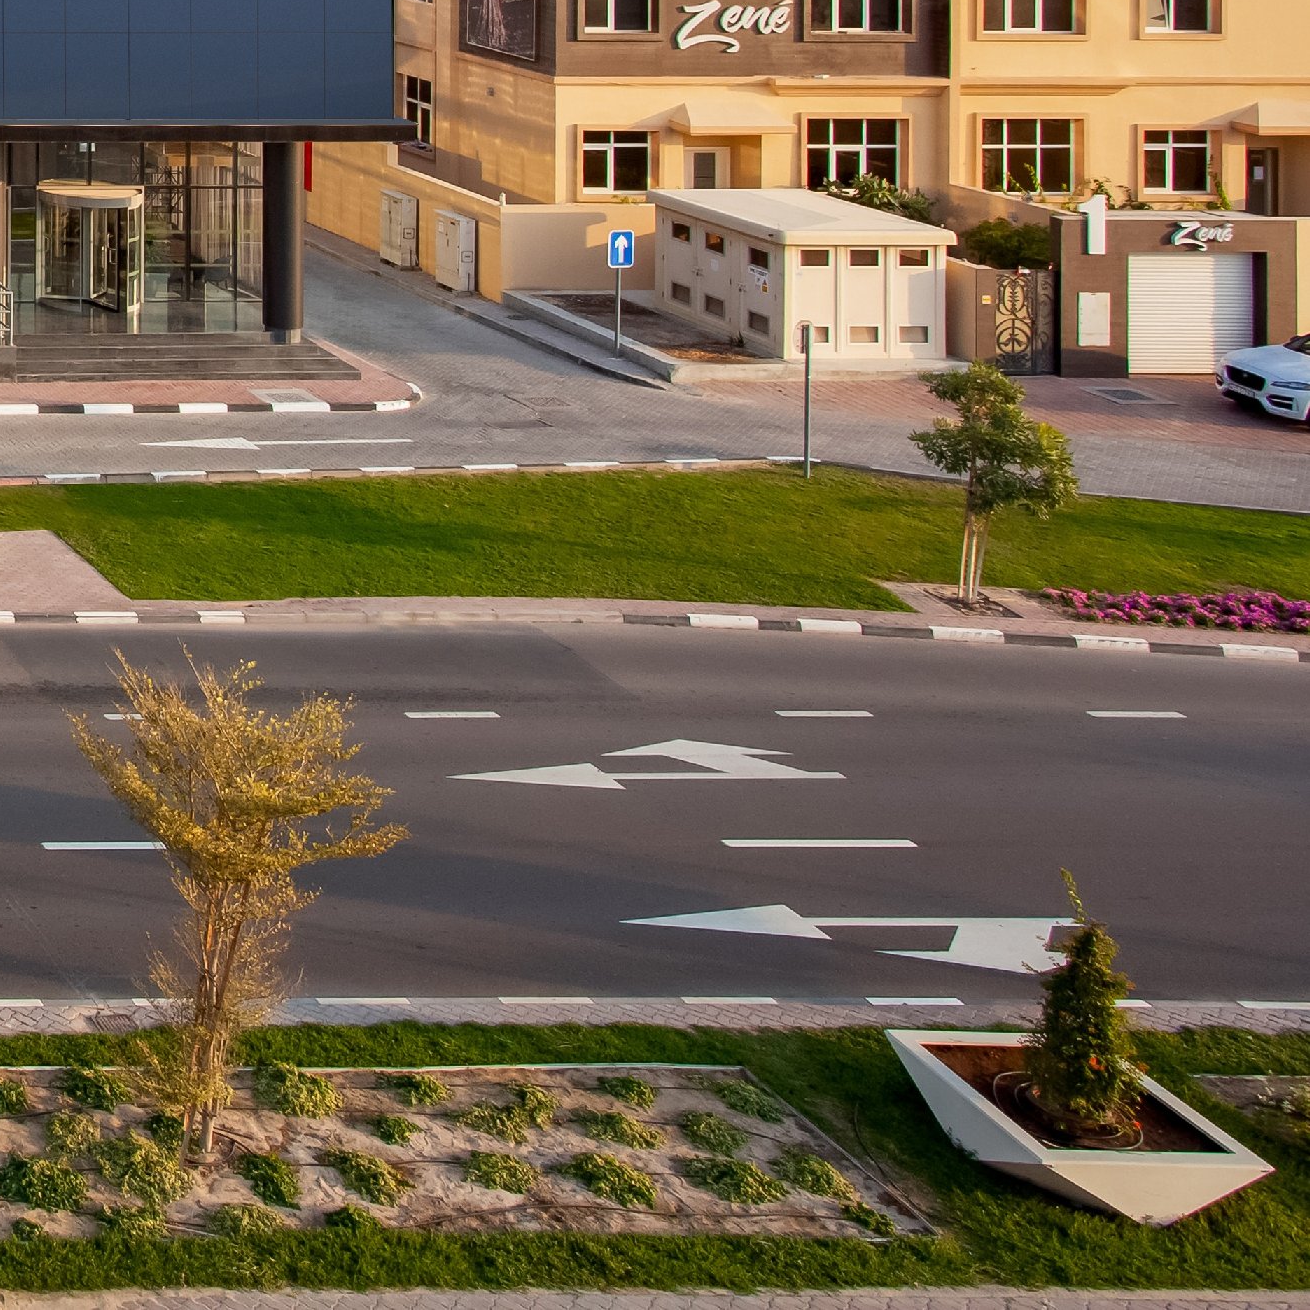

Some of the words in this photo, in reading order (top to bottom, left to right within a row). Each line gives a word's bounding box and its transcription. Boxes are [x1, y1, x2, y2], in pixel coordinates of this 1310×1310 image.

[676, 0, 793, 53] Zené
[1078, 194, 1107, 255] 1
[1171, 221, 1235, 252] Zené
